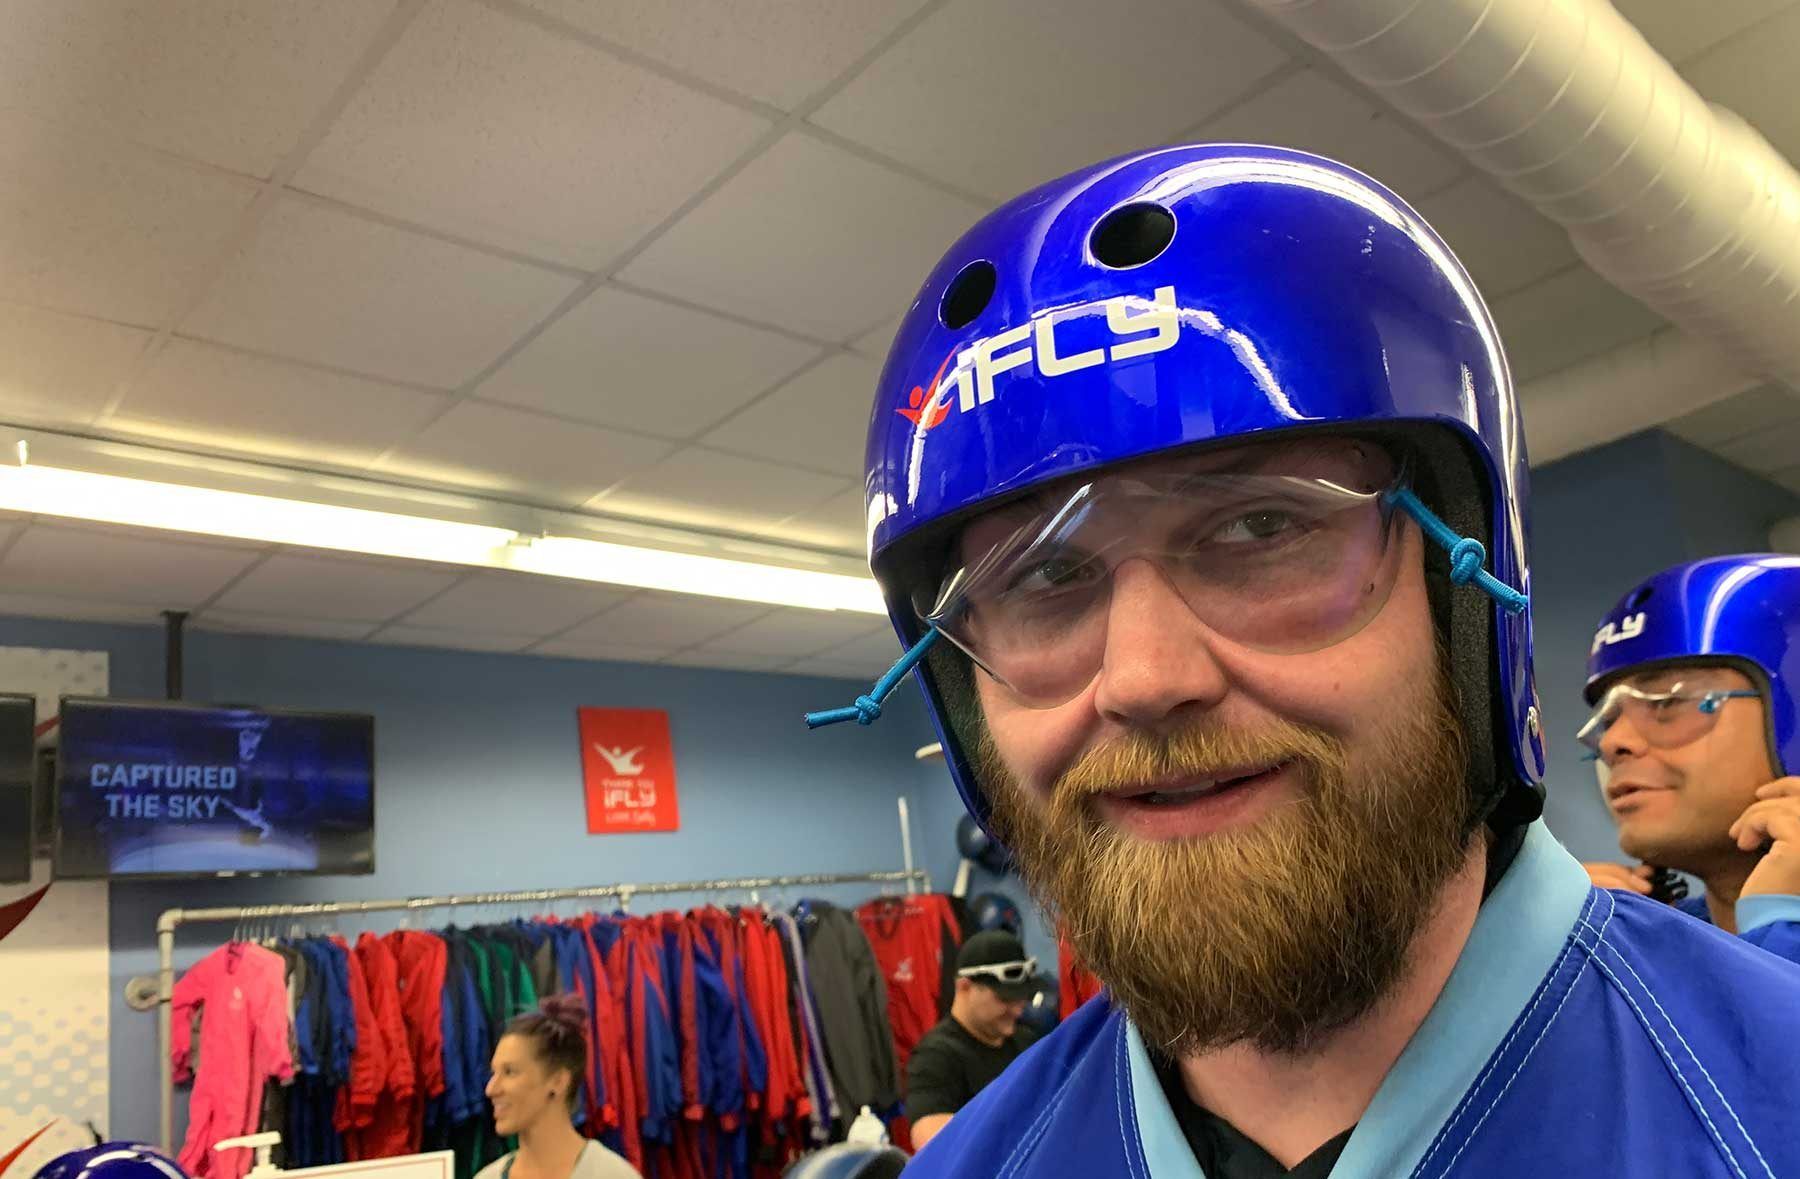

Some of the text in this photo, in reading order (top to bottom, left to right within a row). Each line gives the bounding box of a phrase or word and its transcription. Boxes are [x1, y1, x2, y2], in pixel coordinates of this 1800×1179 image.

[90, 763, 237, 790] CAPTURED
[105, 794, 222, 818] THE SKY
